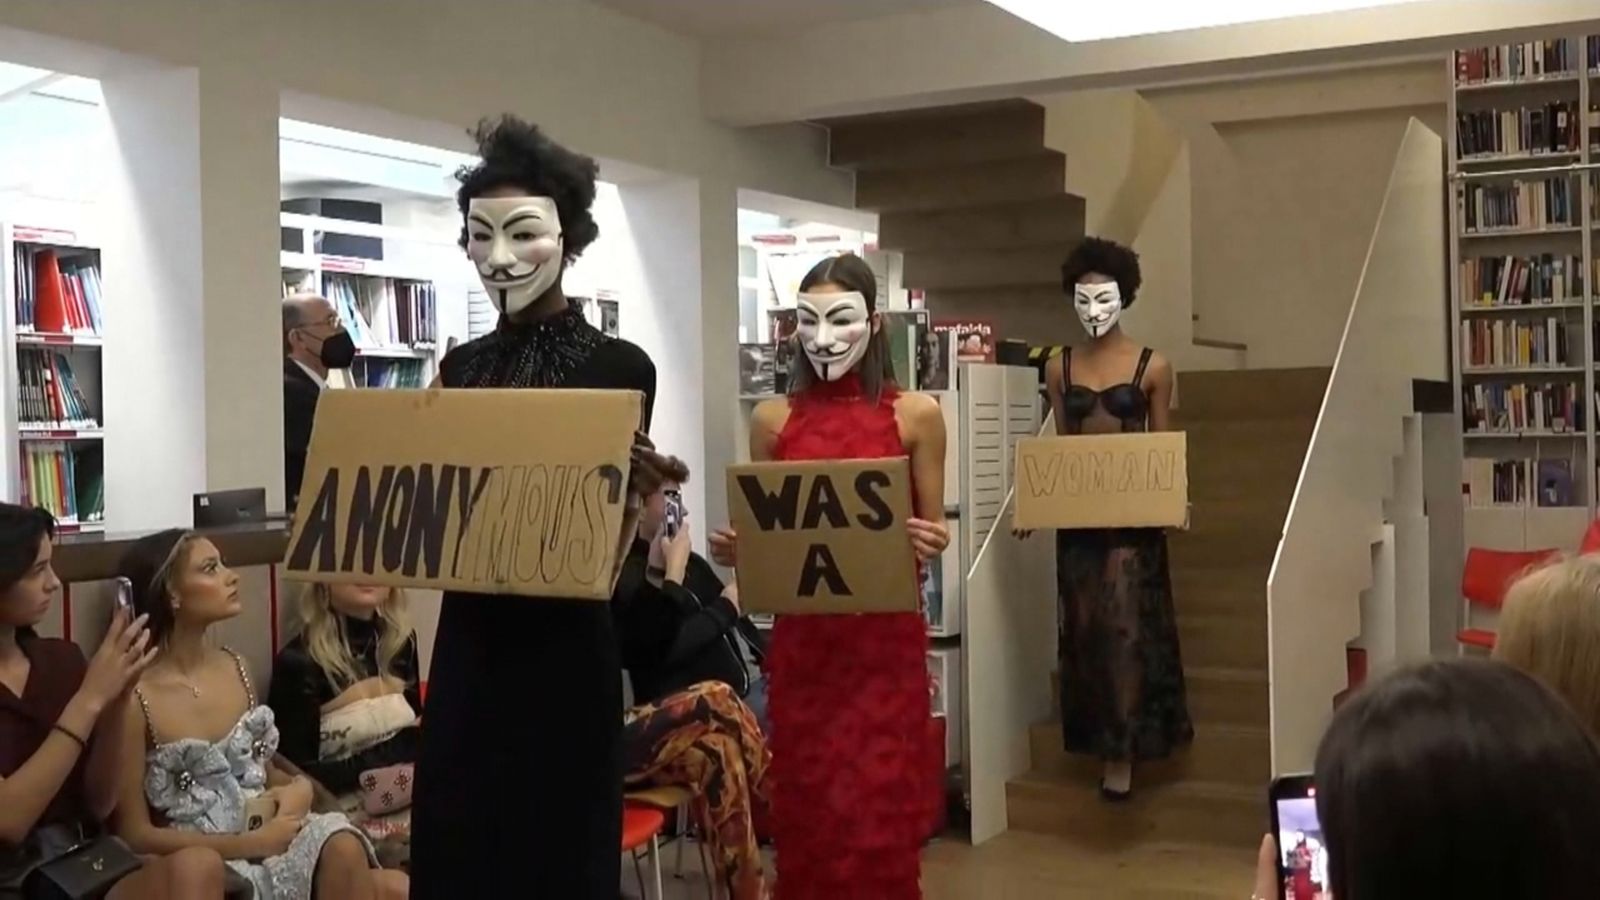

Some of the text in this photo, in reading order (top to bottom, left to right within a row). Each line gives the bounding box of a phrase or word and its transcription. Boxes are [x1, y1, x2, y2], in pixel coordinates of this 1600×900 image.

[736, 470, 893, 531] WAS
[1022, 449, 1175, 498] WOMAN
[286, 463, 623, 585] ANONYMOUS
[797, 543, 853, 597] A
